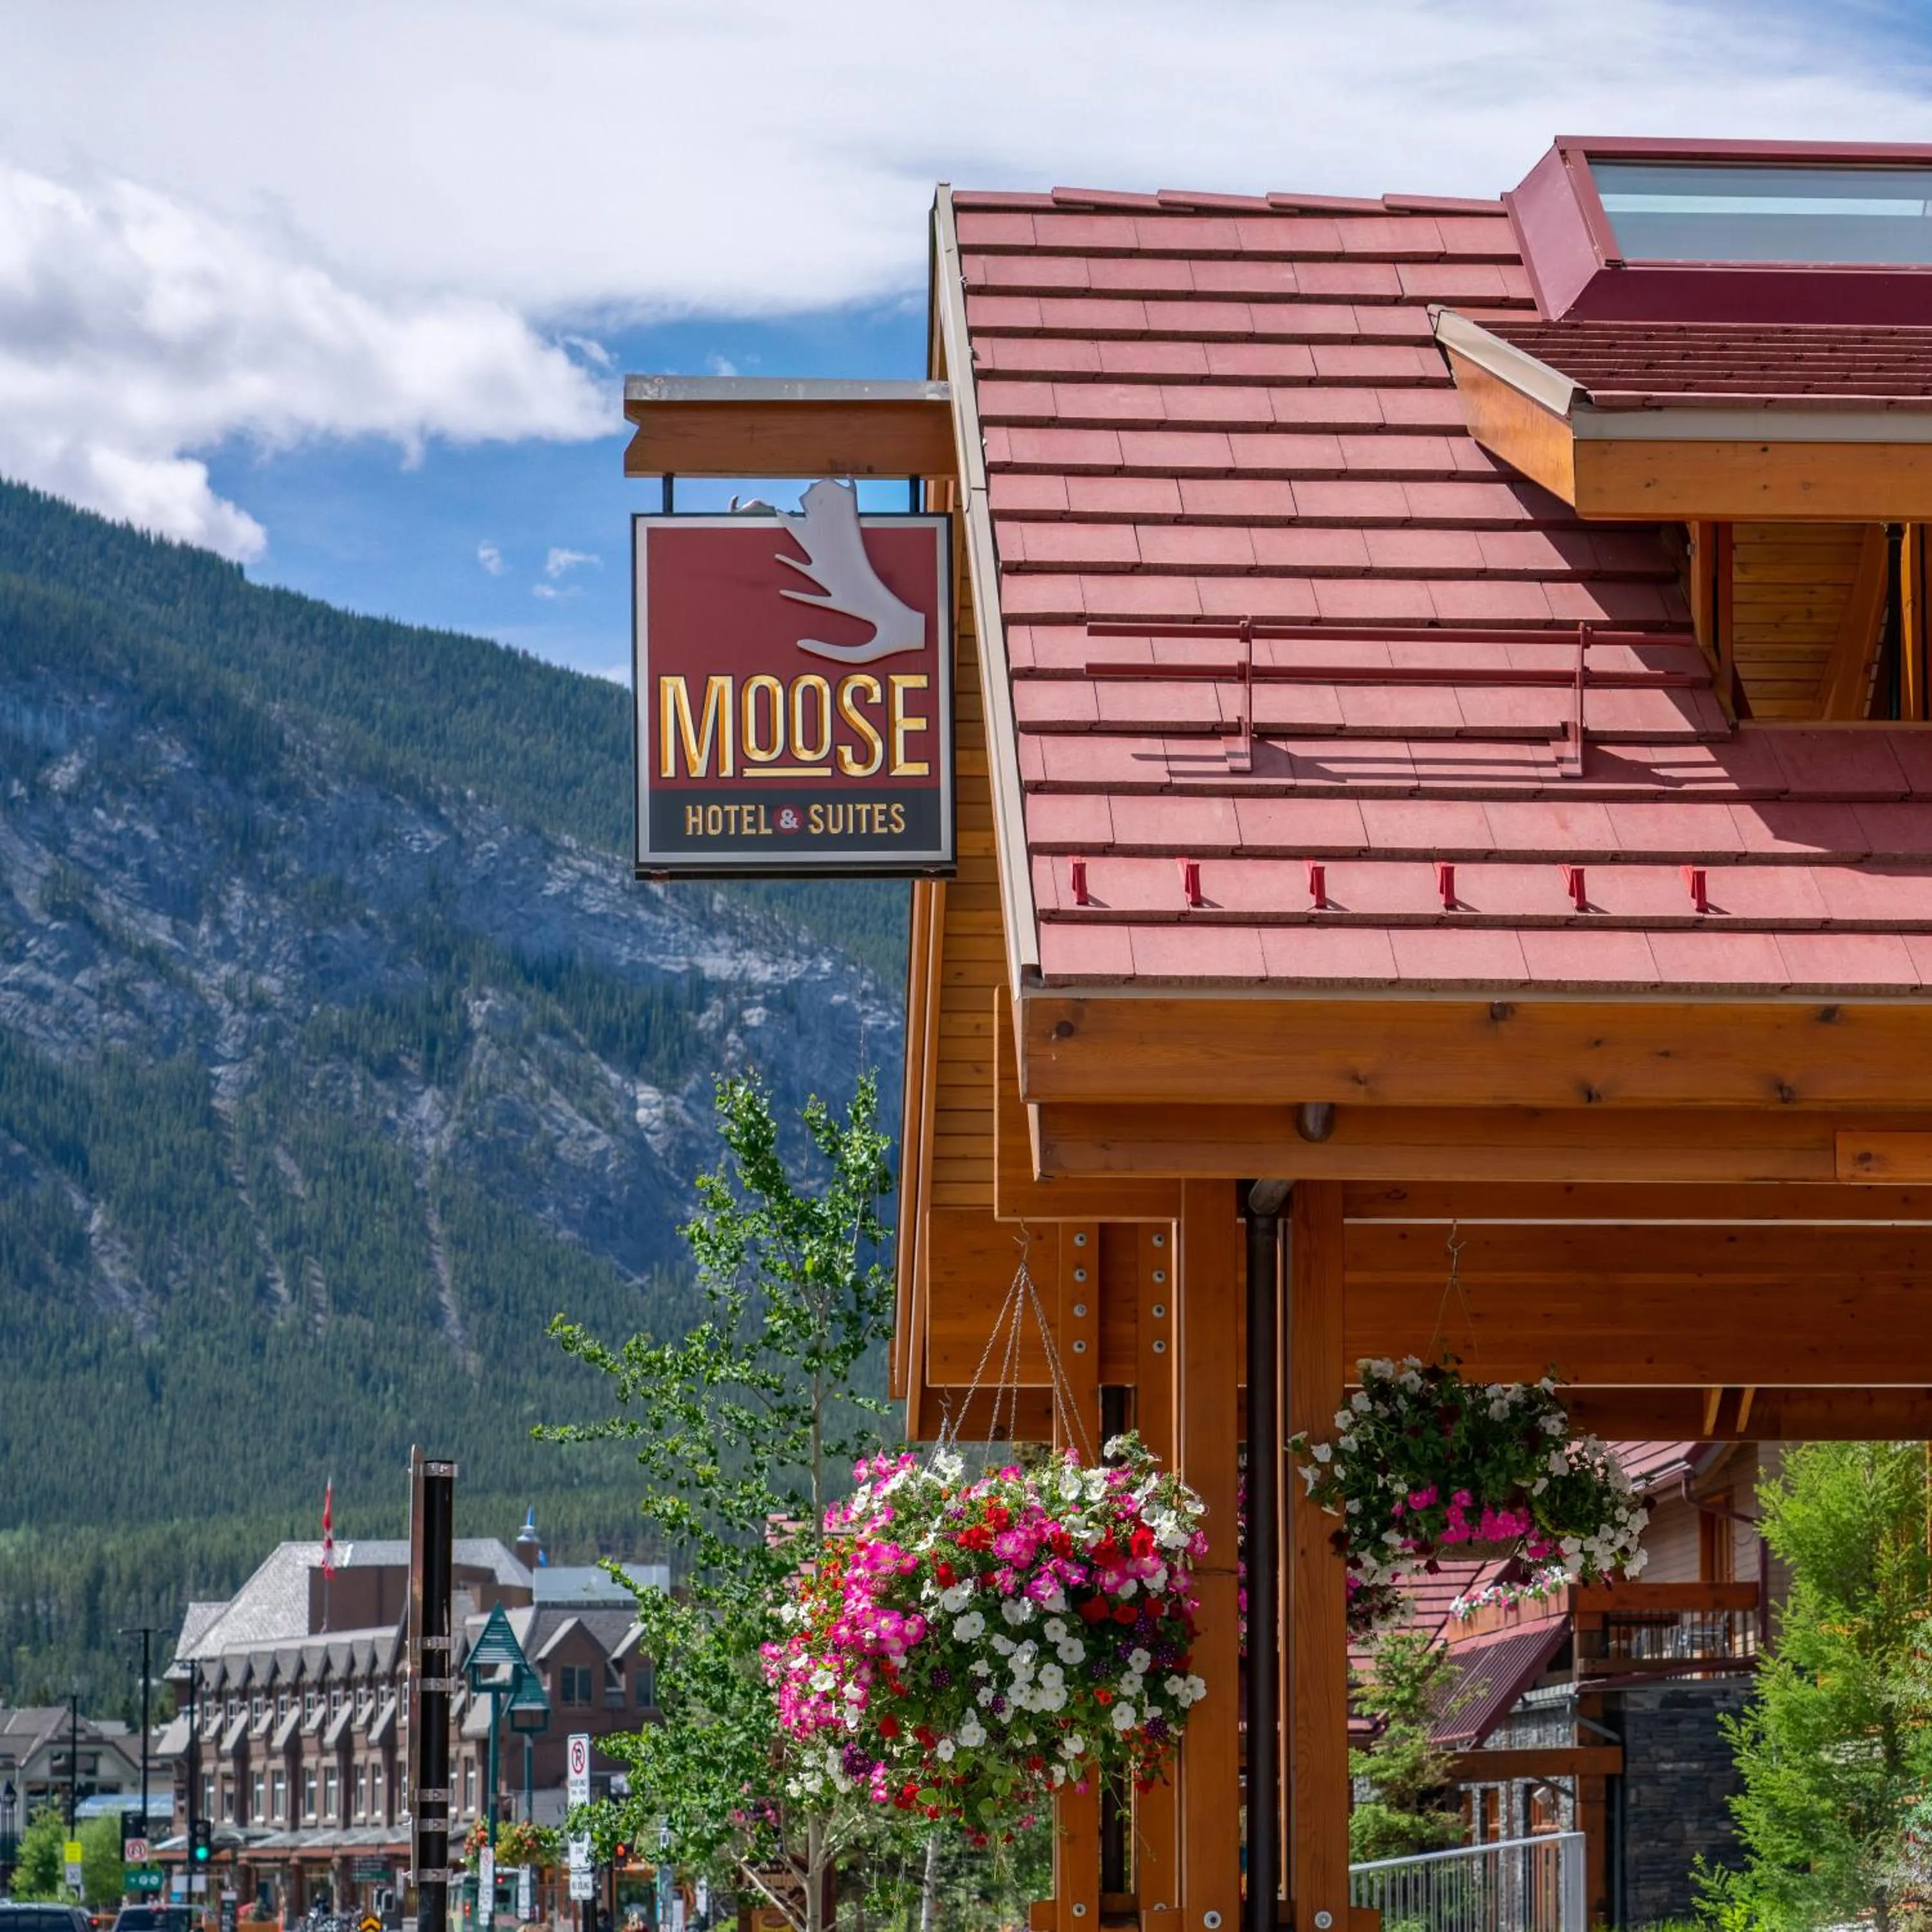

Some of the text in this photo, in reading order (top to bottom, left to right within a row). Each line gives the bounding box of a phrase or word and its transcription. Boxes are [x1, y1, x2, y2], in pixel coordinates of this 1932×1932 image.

[659, 673, 931, 777] MOOSE
[685, 803, 906, 835] HOTEL & SUITES
